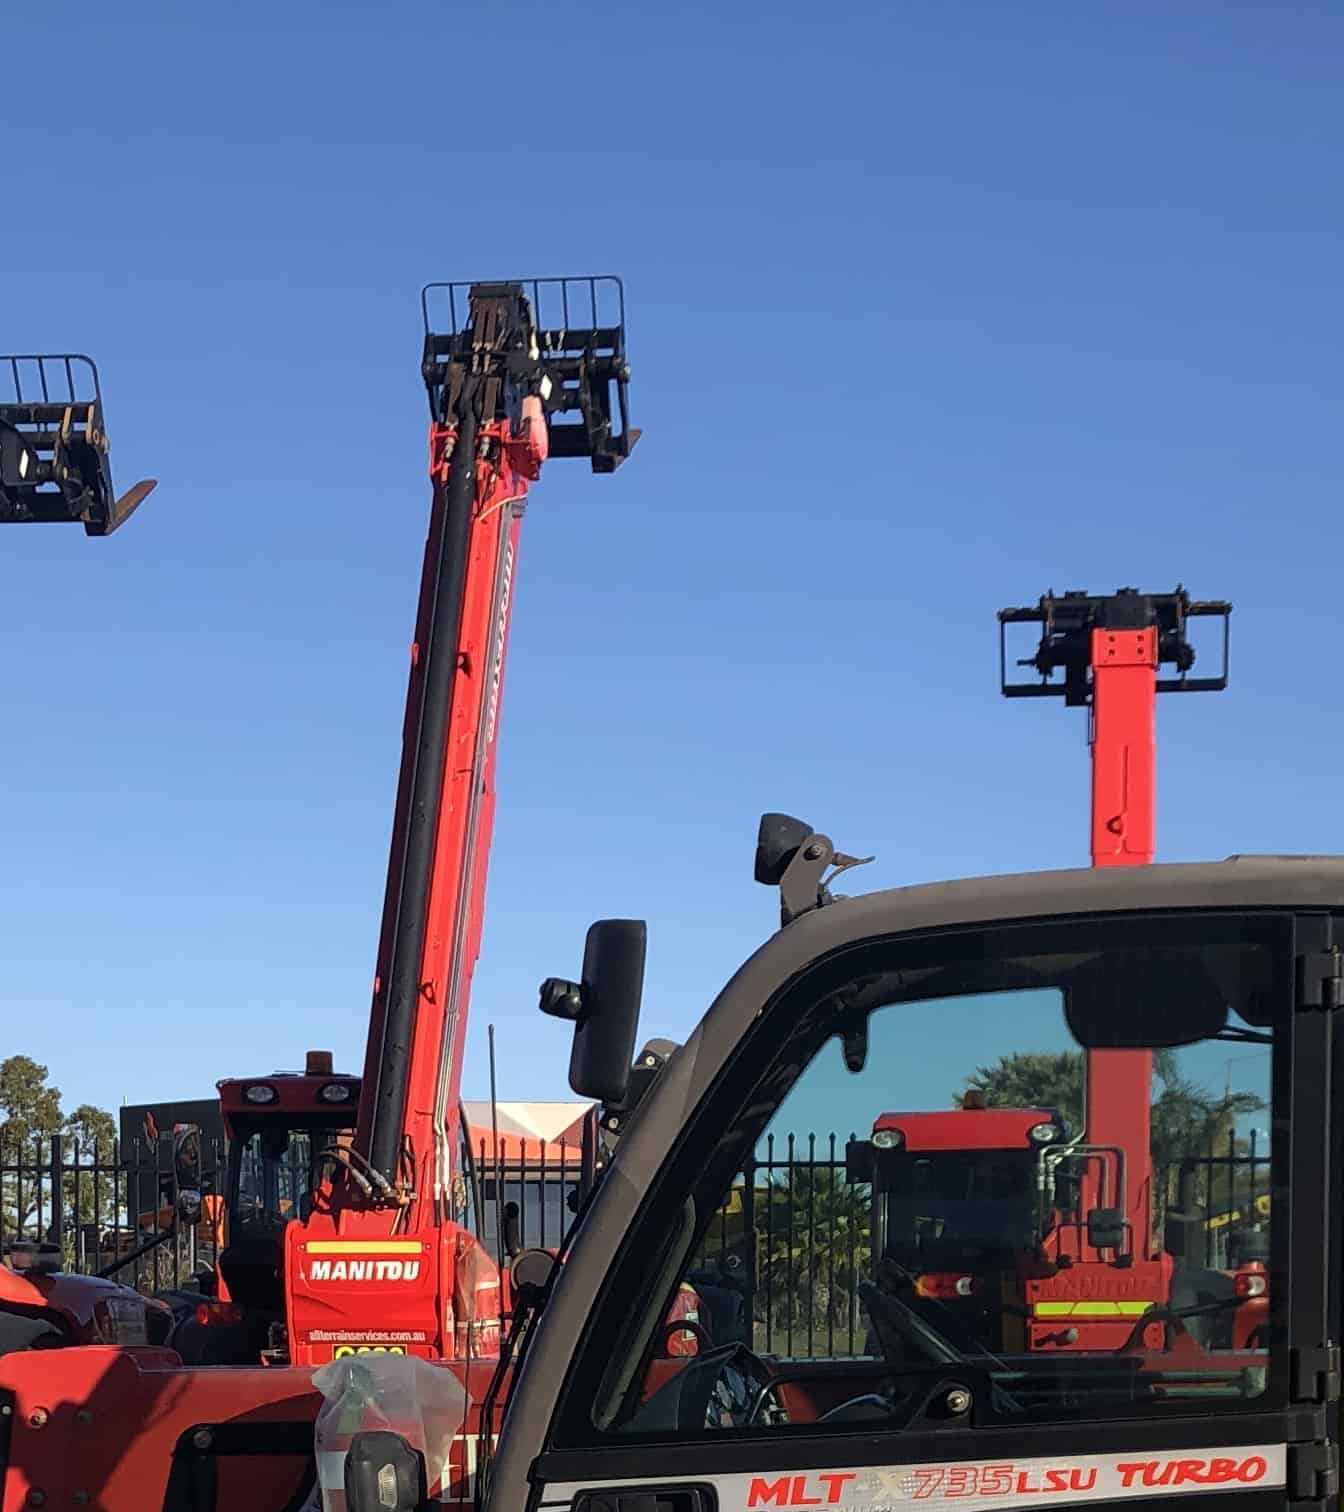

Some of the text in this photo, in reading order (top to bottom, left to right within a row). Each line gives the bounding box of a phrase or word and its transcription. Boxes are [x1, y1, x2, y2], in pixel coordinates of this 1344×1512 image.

[311, 1261, 420, 1281] MANITOU
[309, 1330, 425, 1343] allterrainservices.com.au
[1117, 1456, 1267, 1487] TURBO
